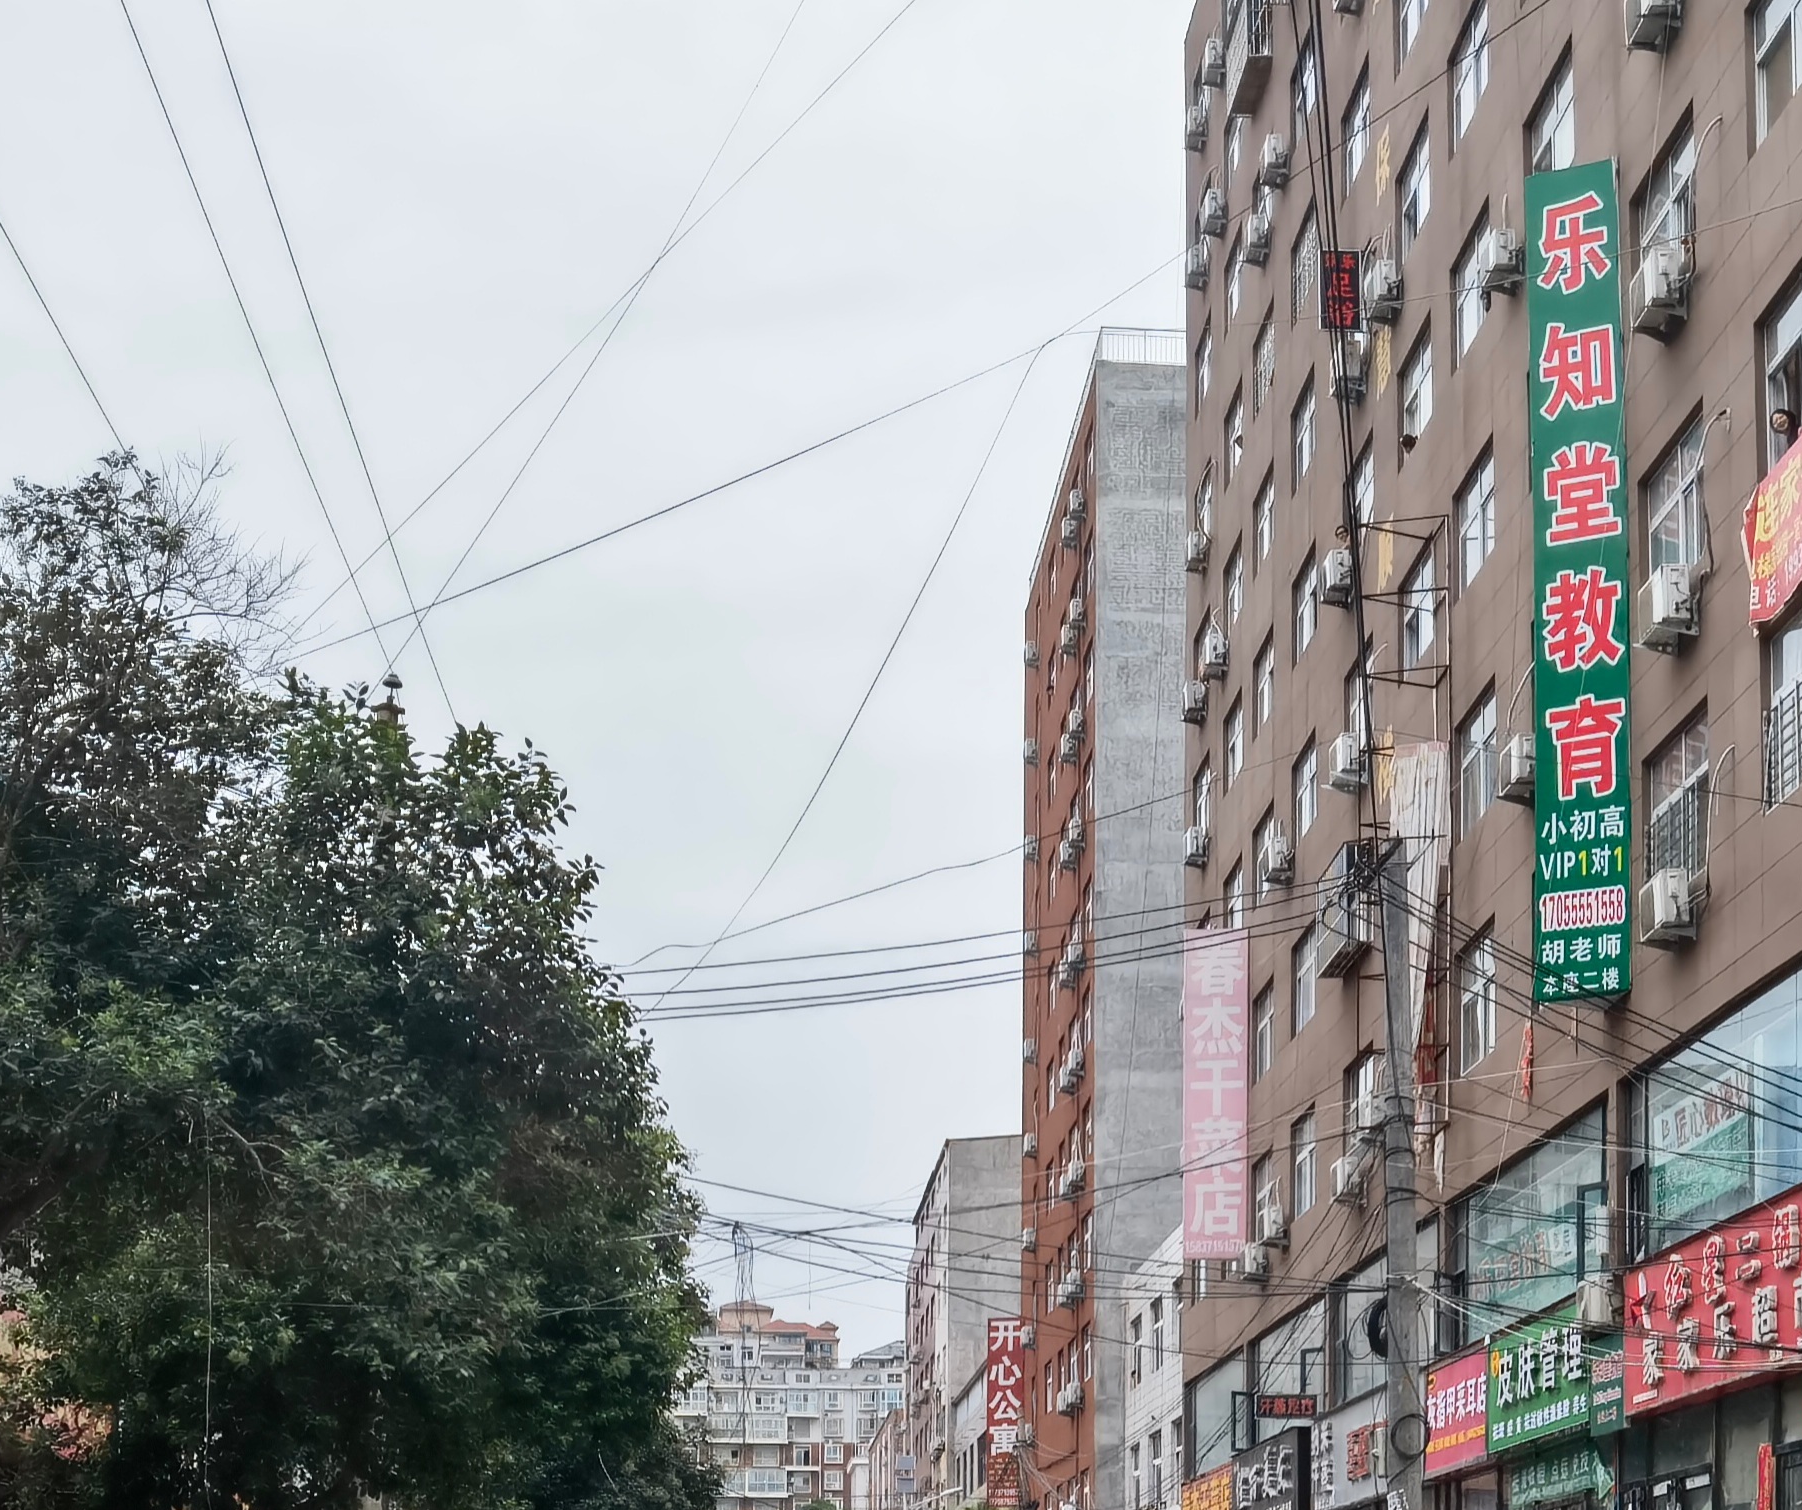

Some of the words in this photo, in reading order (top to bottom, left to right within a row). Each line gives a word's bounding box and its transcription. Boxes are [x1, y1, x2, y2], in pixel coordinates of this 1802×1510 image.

[1538, 190, 1626, 799] 乐知堂教育
[1541, 804, 1626, 844] 小初高
[1539, 843, 1623, 880] VIP1对1
[1541, 933, 1622, 966] 胡老师
[1542, 967, 1620, 996] 本座二楼
[1496, 1321, 1584, 1409] 皮肤管理
[988, 1319, 1022, 1457] 开心公寓
